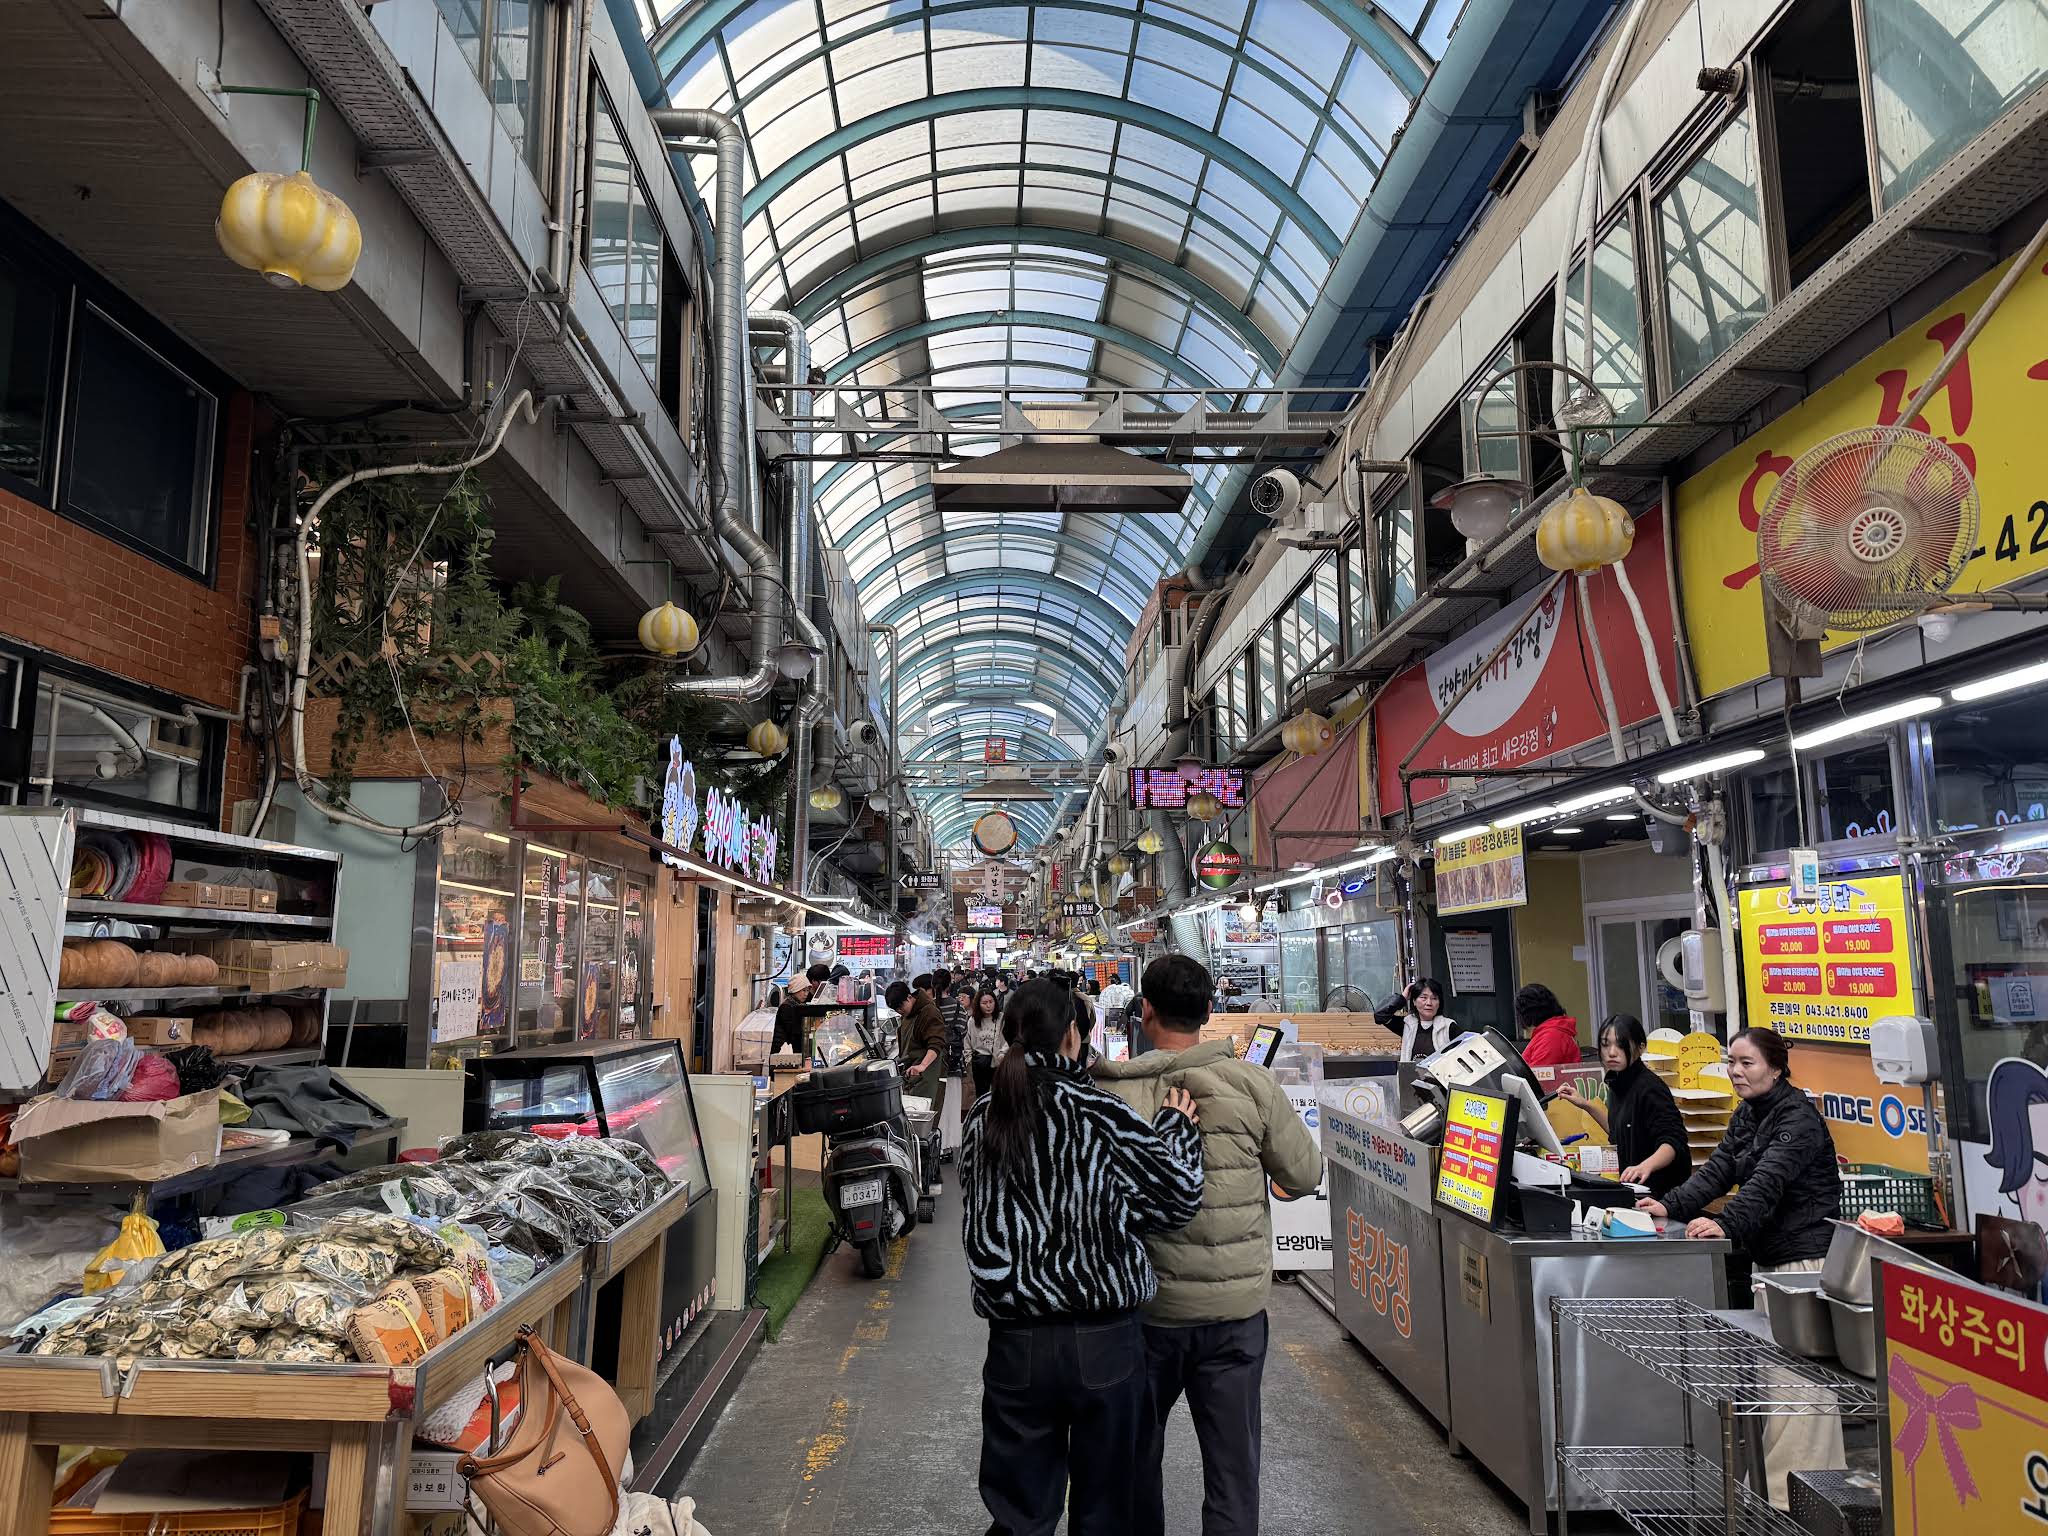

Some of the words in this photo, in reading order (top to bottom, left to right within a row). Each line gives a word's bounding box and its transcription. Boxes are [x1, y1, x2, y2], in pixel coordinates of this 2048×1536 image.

[1482, 746, 1499, 769] 최고
[1501, 726, 1539, 762] 새우강정
[920, 875, 939, 883] 화장실
[1780, 941, 1803, 952] 20,000
[1844, 939, 1871, 951] 19,000
[1783, 980, 1806, 992] 20,000
[1848, 982, 1874, 994] 19,000
[1769, 1001, 1800, 1016] 주문예약
[1805, 1003, 1869, 1019] 043.421.8400
[1788, 1022, 1804, 1034] 421
[1806, 1024, 1846, 1037] 8400999
[1535, 1070, 1552, 1079] ize
[1823, 1093, 1873, 1124] MBC
[853, 1189, 876, 1201] 0347
[1276, 1235, 1333, 1251] 단양마늘
[1346, 1206, 1412, 1339] 닭강정
[1900, 1283, 2026, 1372] 화상주의
